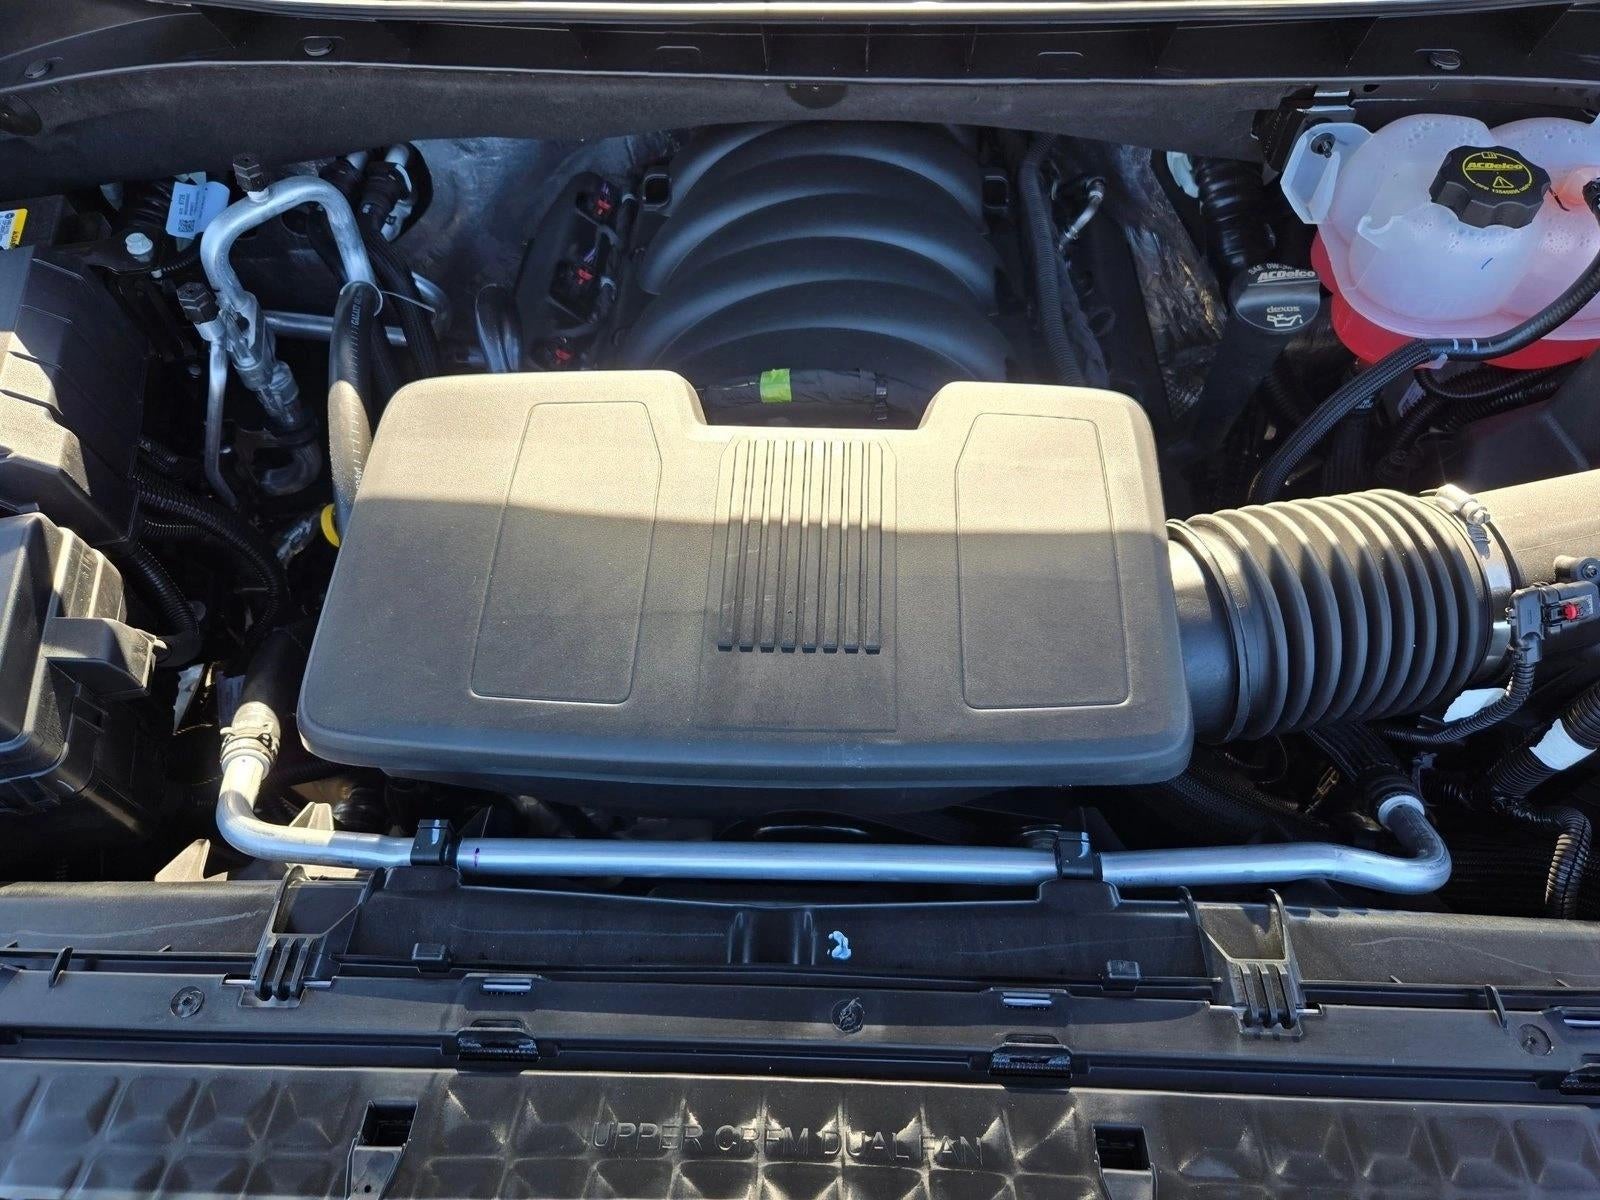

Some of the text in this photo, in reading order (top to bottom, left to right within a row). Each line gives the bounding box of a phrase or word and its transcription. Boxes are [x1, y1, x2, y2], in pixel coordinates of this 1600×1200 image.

[1465, 162, 1524, 171] ACDelco
[1257, 269, 1316, 284] ACDelco
[1266, 305, 1301, 313] dexos
[592, 1121, 704, 1152] UPPER
[821, 1129, 911, 1161] DUAL
[918, 1134, 985, 1168] FAN
